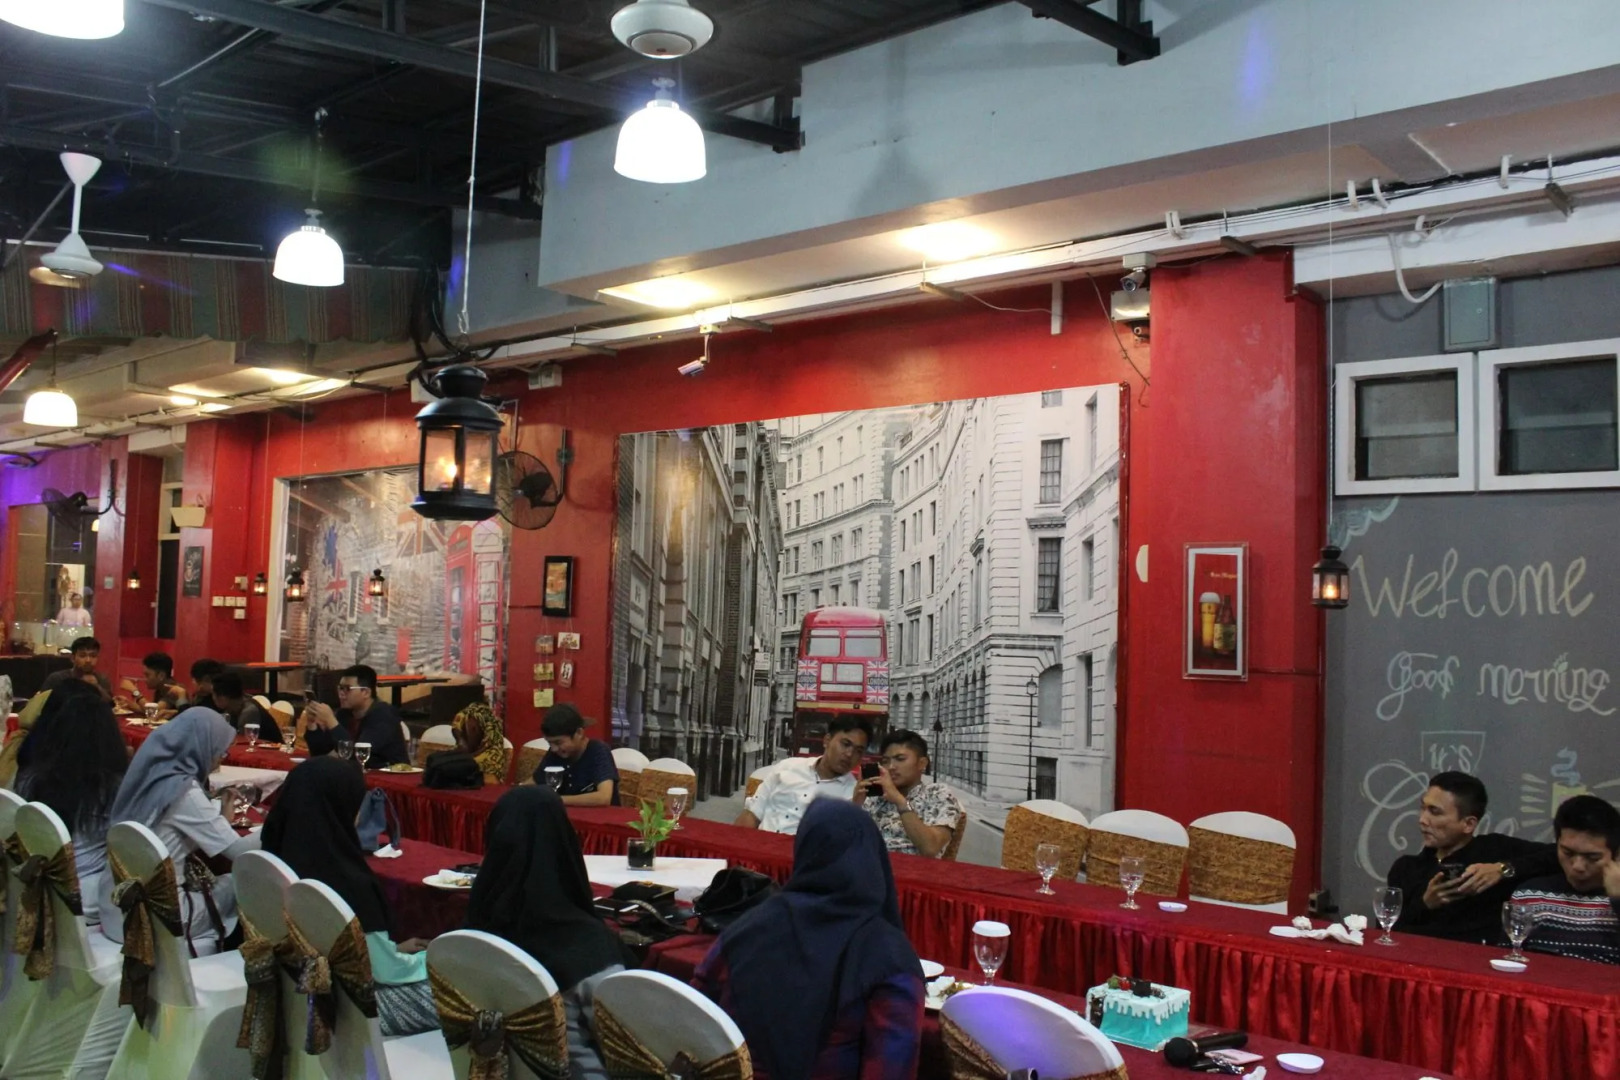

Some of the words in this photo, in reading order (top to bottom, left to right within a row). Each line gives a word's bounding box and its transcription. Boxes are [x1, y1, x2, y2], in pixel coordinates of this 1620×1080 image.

[1351, 547, 1594, 618] Welcome
[868, 677, 889, 686] LONDON
[1476, 651, 1617, 716] morning
